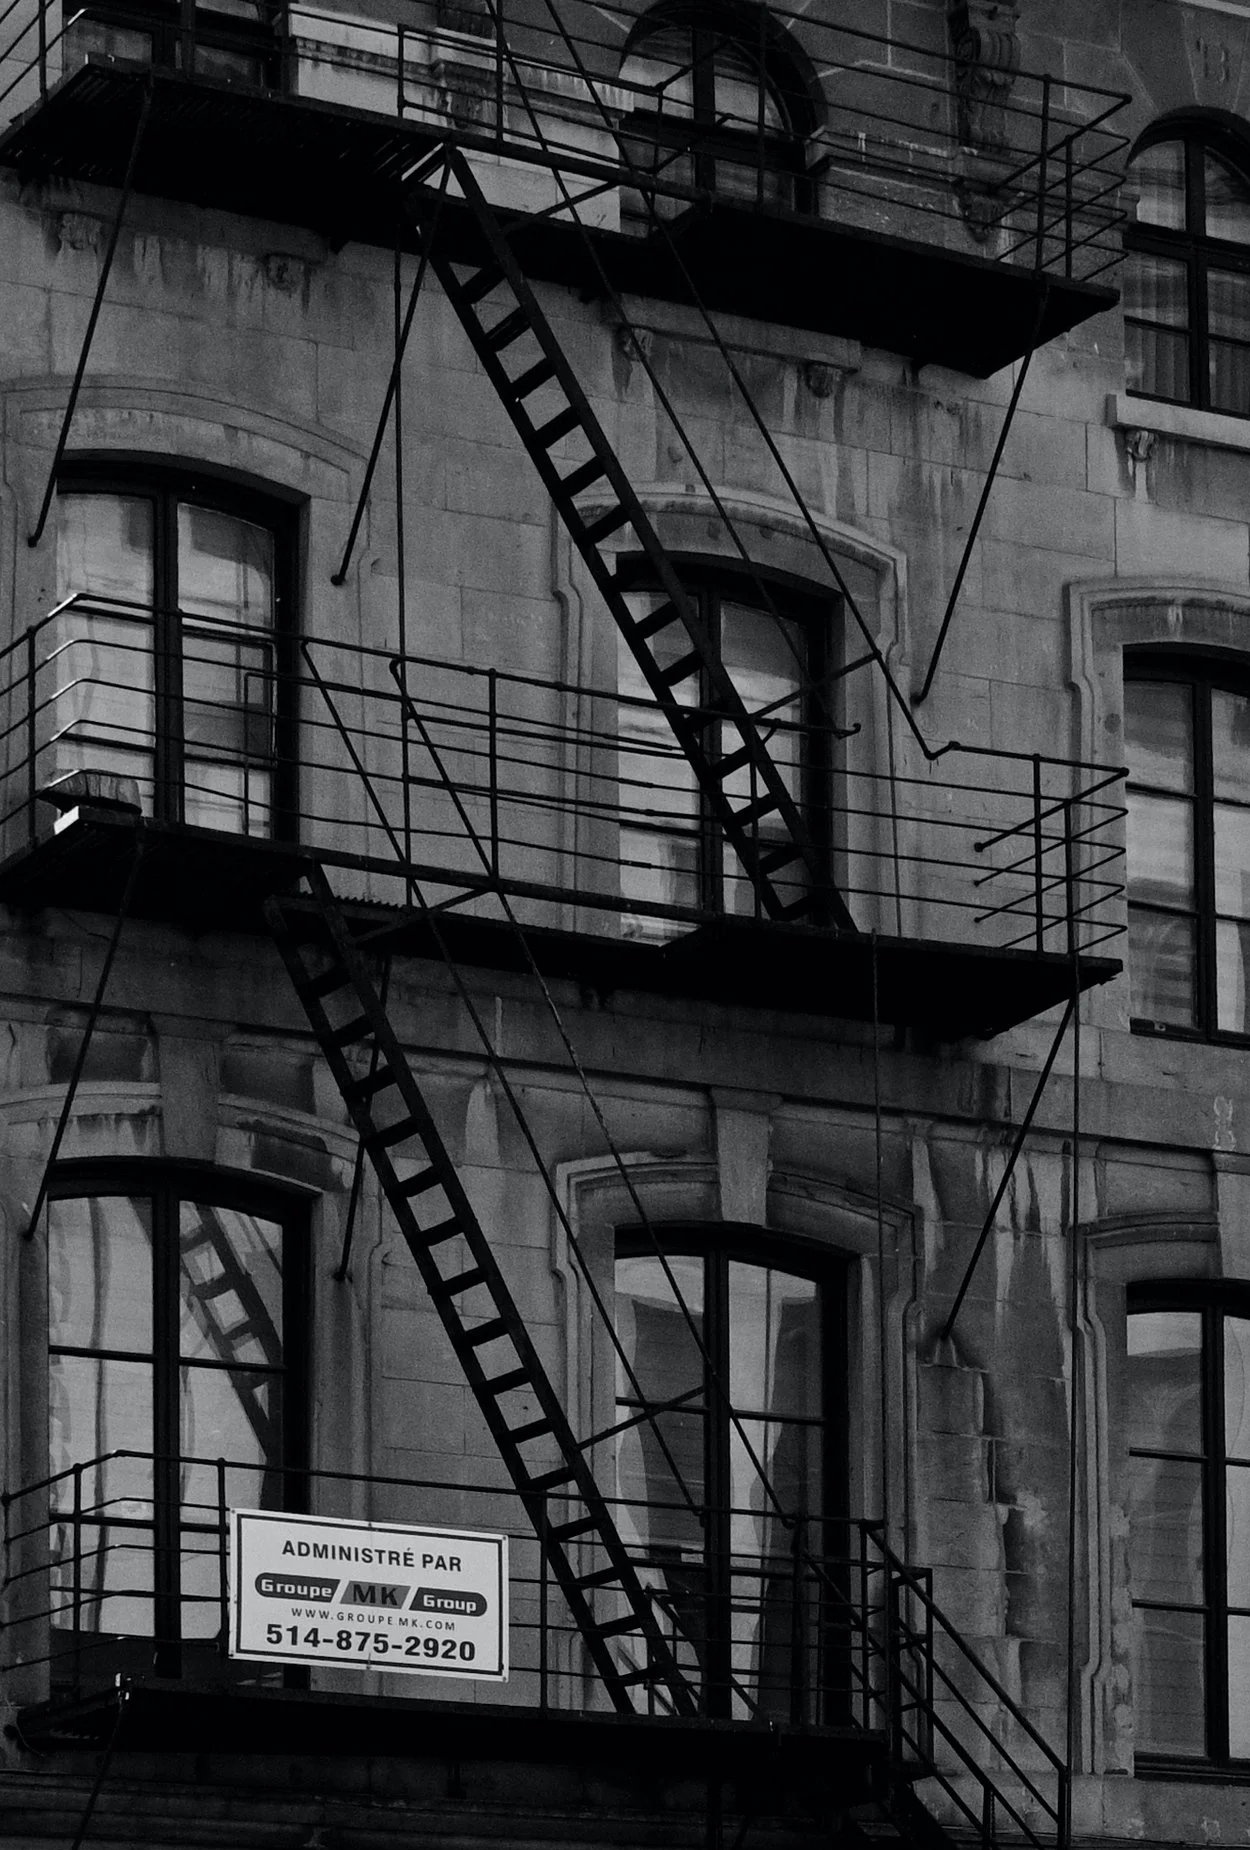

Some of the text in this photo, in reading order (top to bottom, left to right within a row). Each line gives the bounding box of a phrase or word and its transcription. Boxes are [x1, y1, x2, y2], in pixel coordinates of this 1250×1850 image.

[282, 1539, 462, 1572] ADMINISTRÉ PAR
[260, 1577, 478, 1614] Groupe MK Group
[265, 1623, 476, 1662] 514-875-2920
